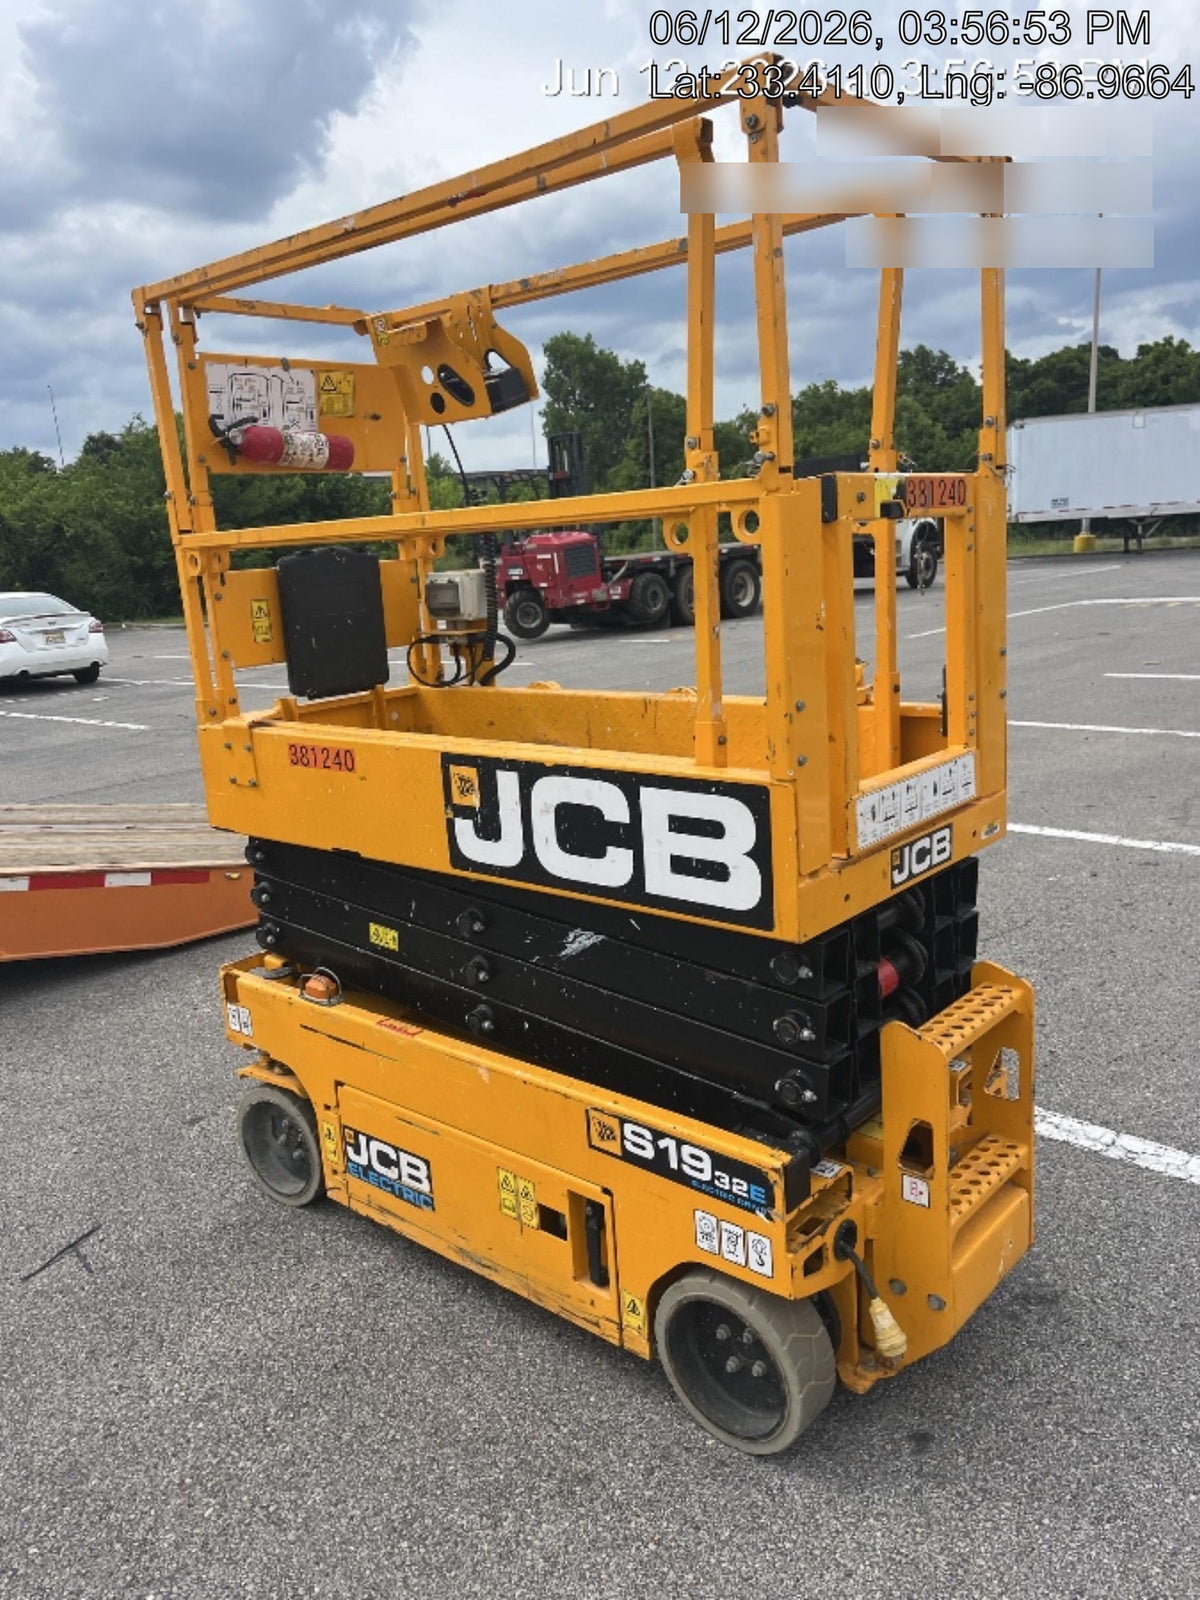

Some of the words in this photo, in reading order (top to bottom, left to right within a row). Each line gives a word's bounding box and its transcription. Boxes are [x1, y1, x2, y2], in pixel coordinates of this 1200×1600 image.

[907, 479, 967, 508] 381240
[288, 744, 355, 772] 381240
[454, 768, 762, 911] JCB
[892, 827, 951, 885] JCB
[346, 1133, 431, 1194] JCB
[347, 1161, 433, 1210] ELECTRIC
